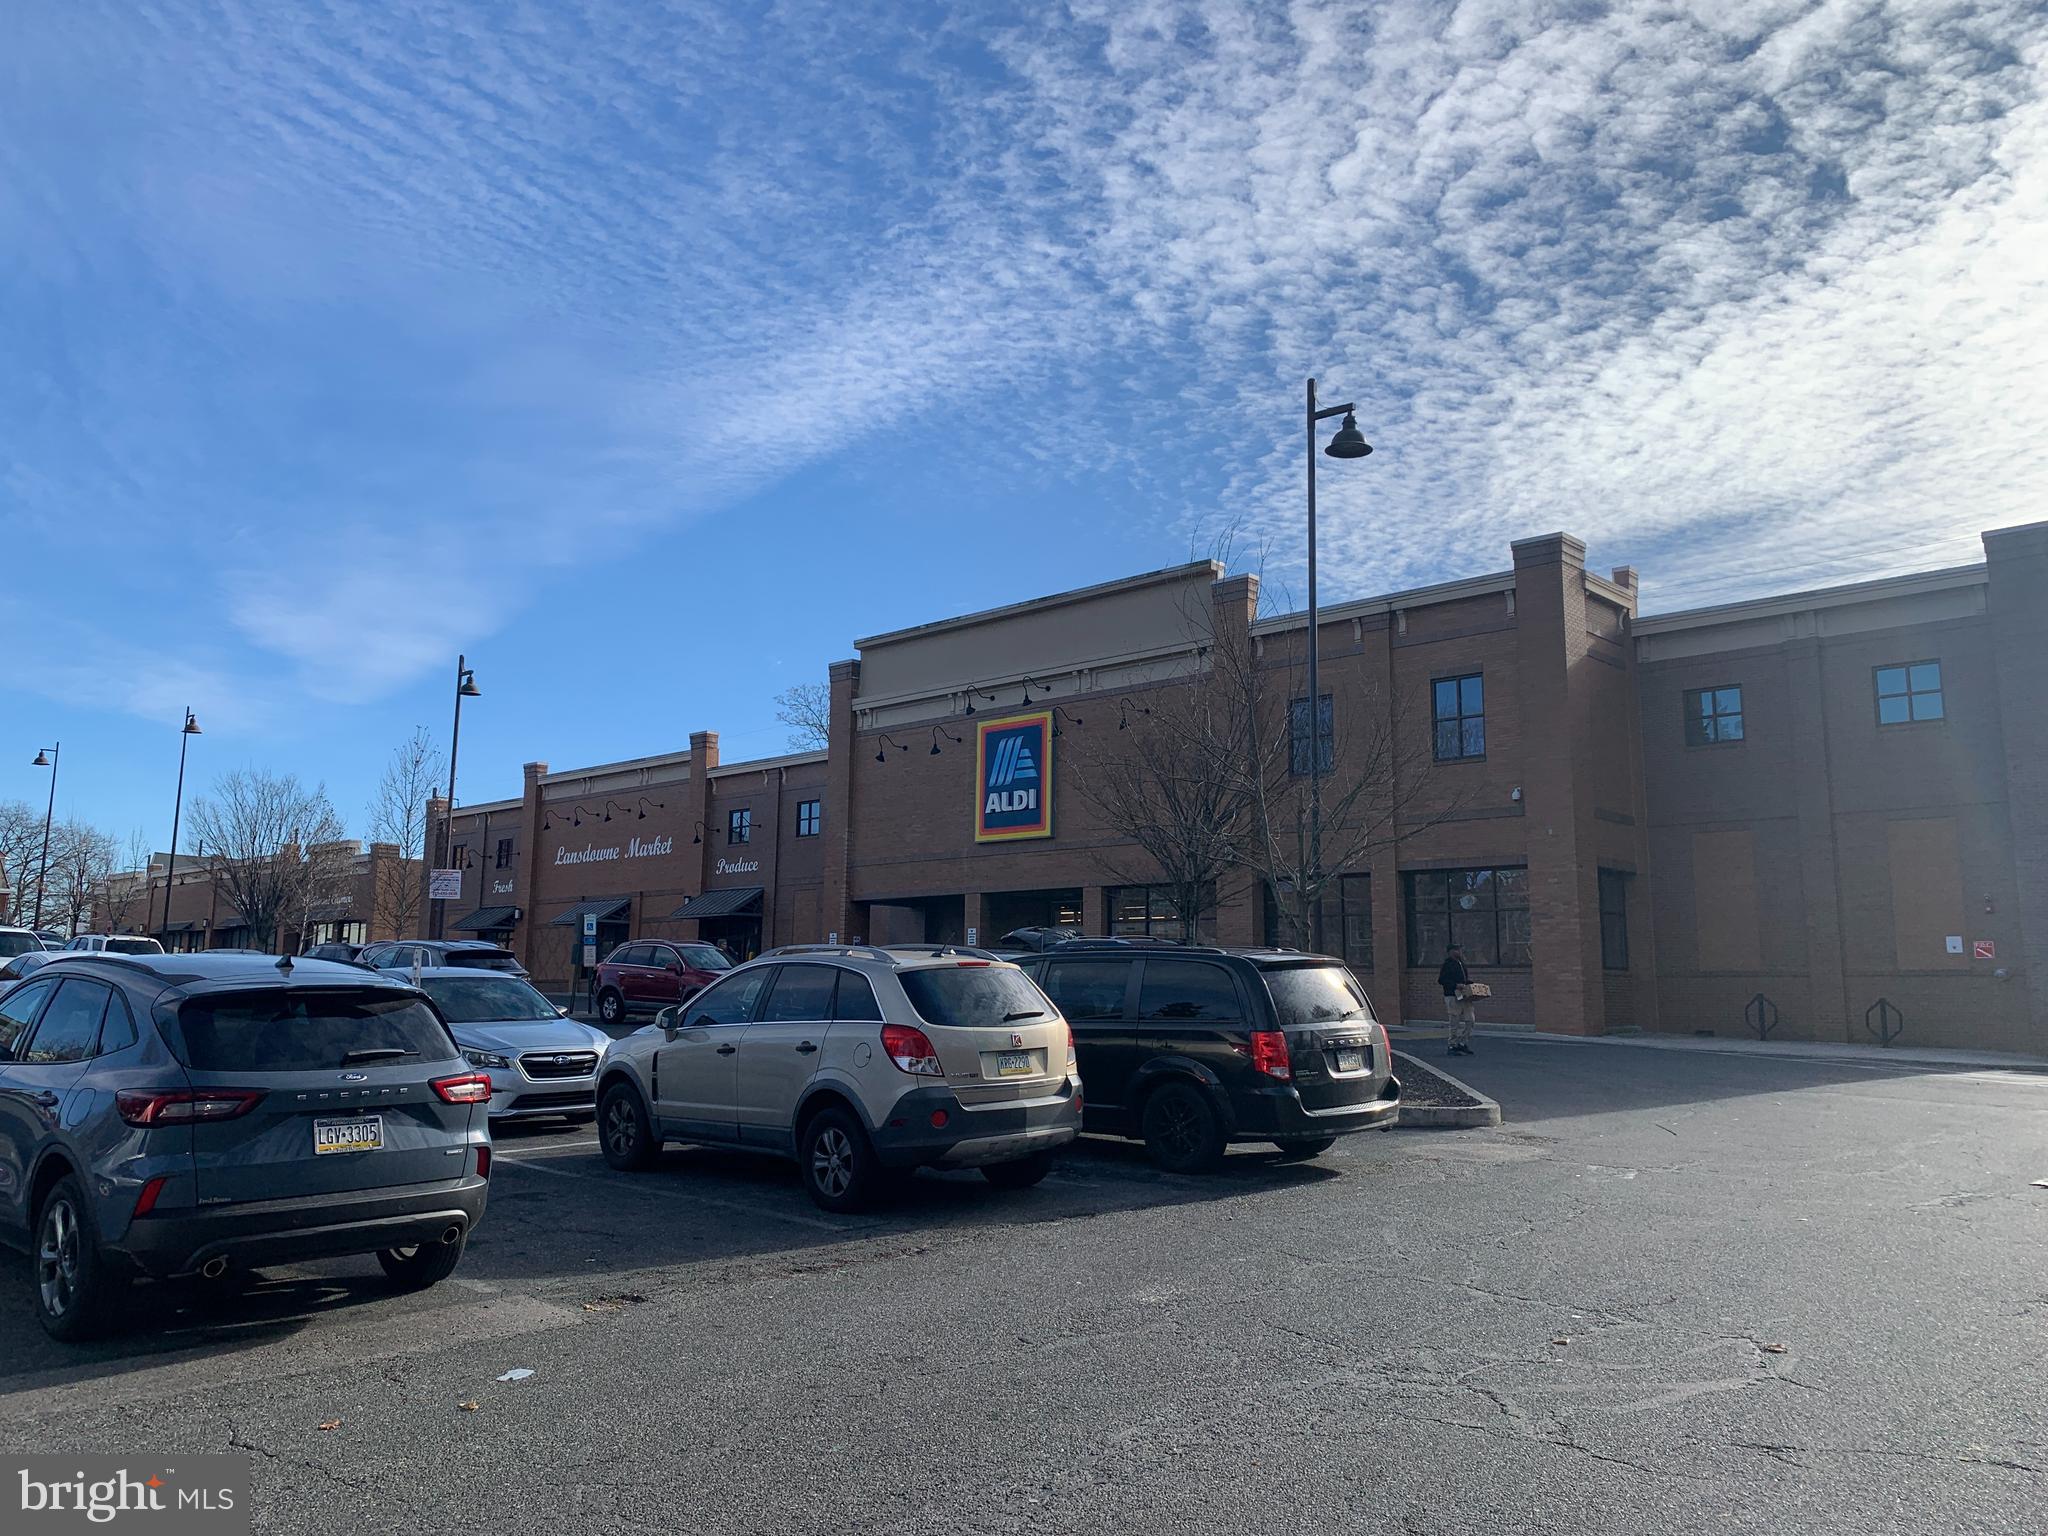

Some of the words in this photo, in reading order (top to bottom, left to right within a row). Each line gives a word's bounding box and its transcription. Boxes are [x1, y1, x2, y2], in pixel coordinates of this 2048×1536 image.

[985, 788, 1037, 814] ALDI
[554, 843, 620, 865] Lansdowne
[624, 835, 673, 858] Market
[715, 856, 759, 875] Produce
[492, 879, 513, 894] Fresh
